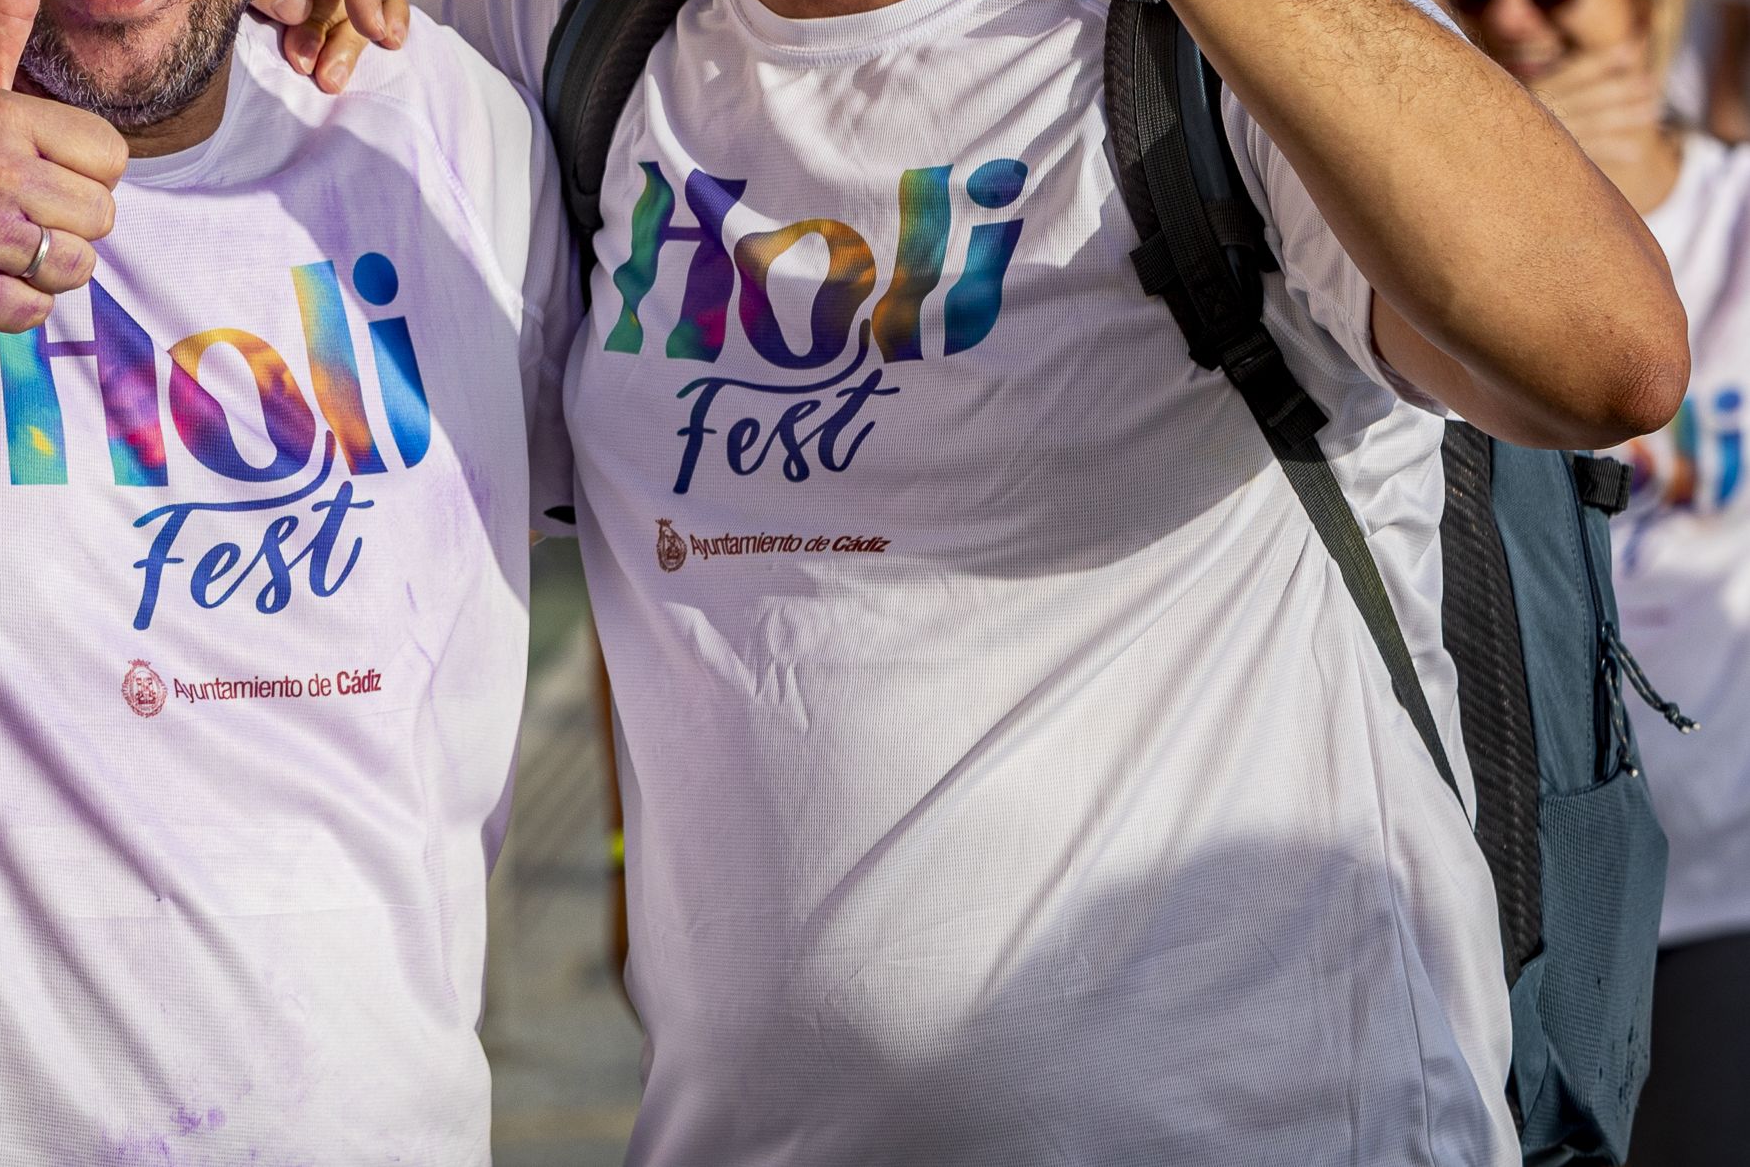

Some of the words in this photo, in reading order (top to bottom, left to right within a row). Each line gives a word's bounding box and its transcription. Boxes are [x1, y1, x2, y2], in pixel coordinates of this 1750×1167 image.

[604, 158, 1028, 369] Holi
[672, 318, 900, 494] Fest
[132, 431, 375, 631] Fest
[689, 532, 802, 560] Ayuntamiento
[804, 535, 830, 553] de
[831, 535, 892, 553] Cádiz
[173, 675, 303, 703] Ayuntamiento
[308, 673, 332, 696] de
[336, 668, 382, 696] Cádiz
